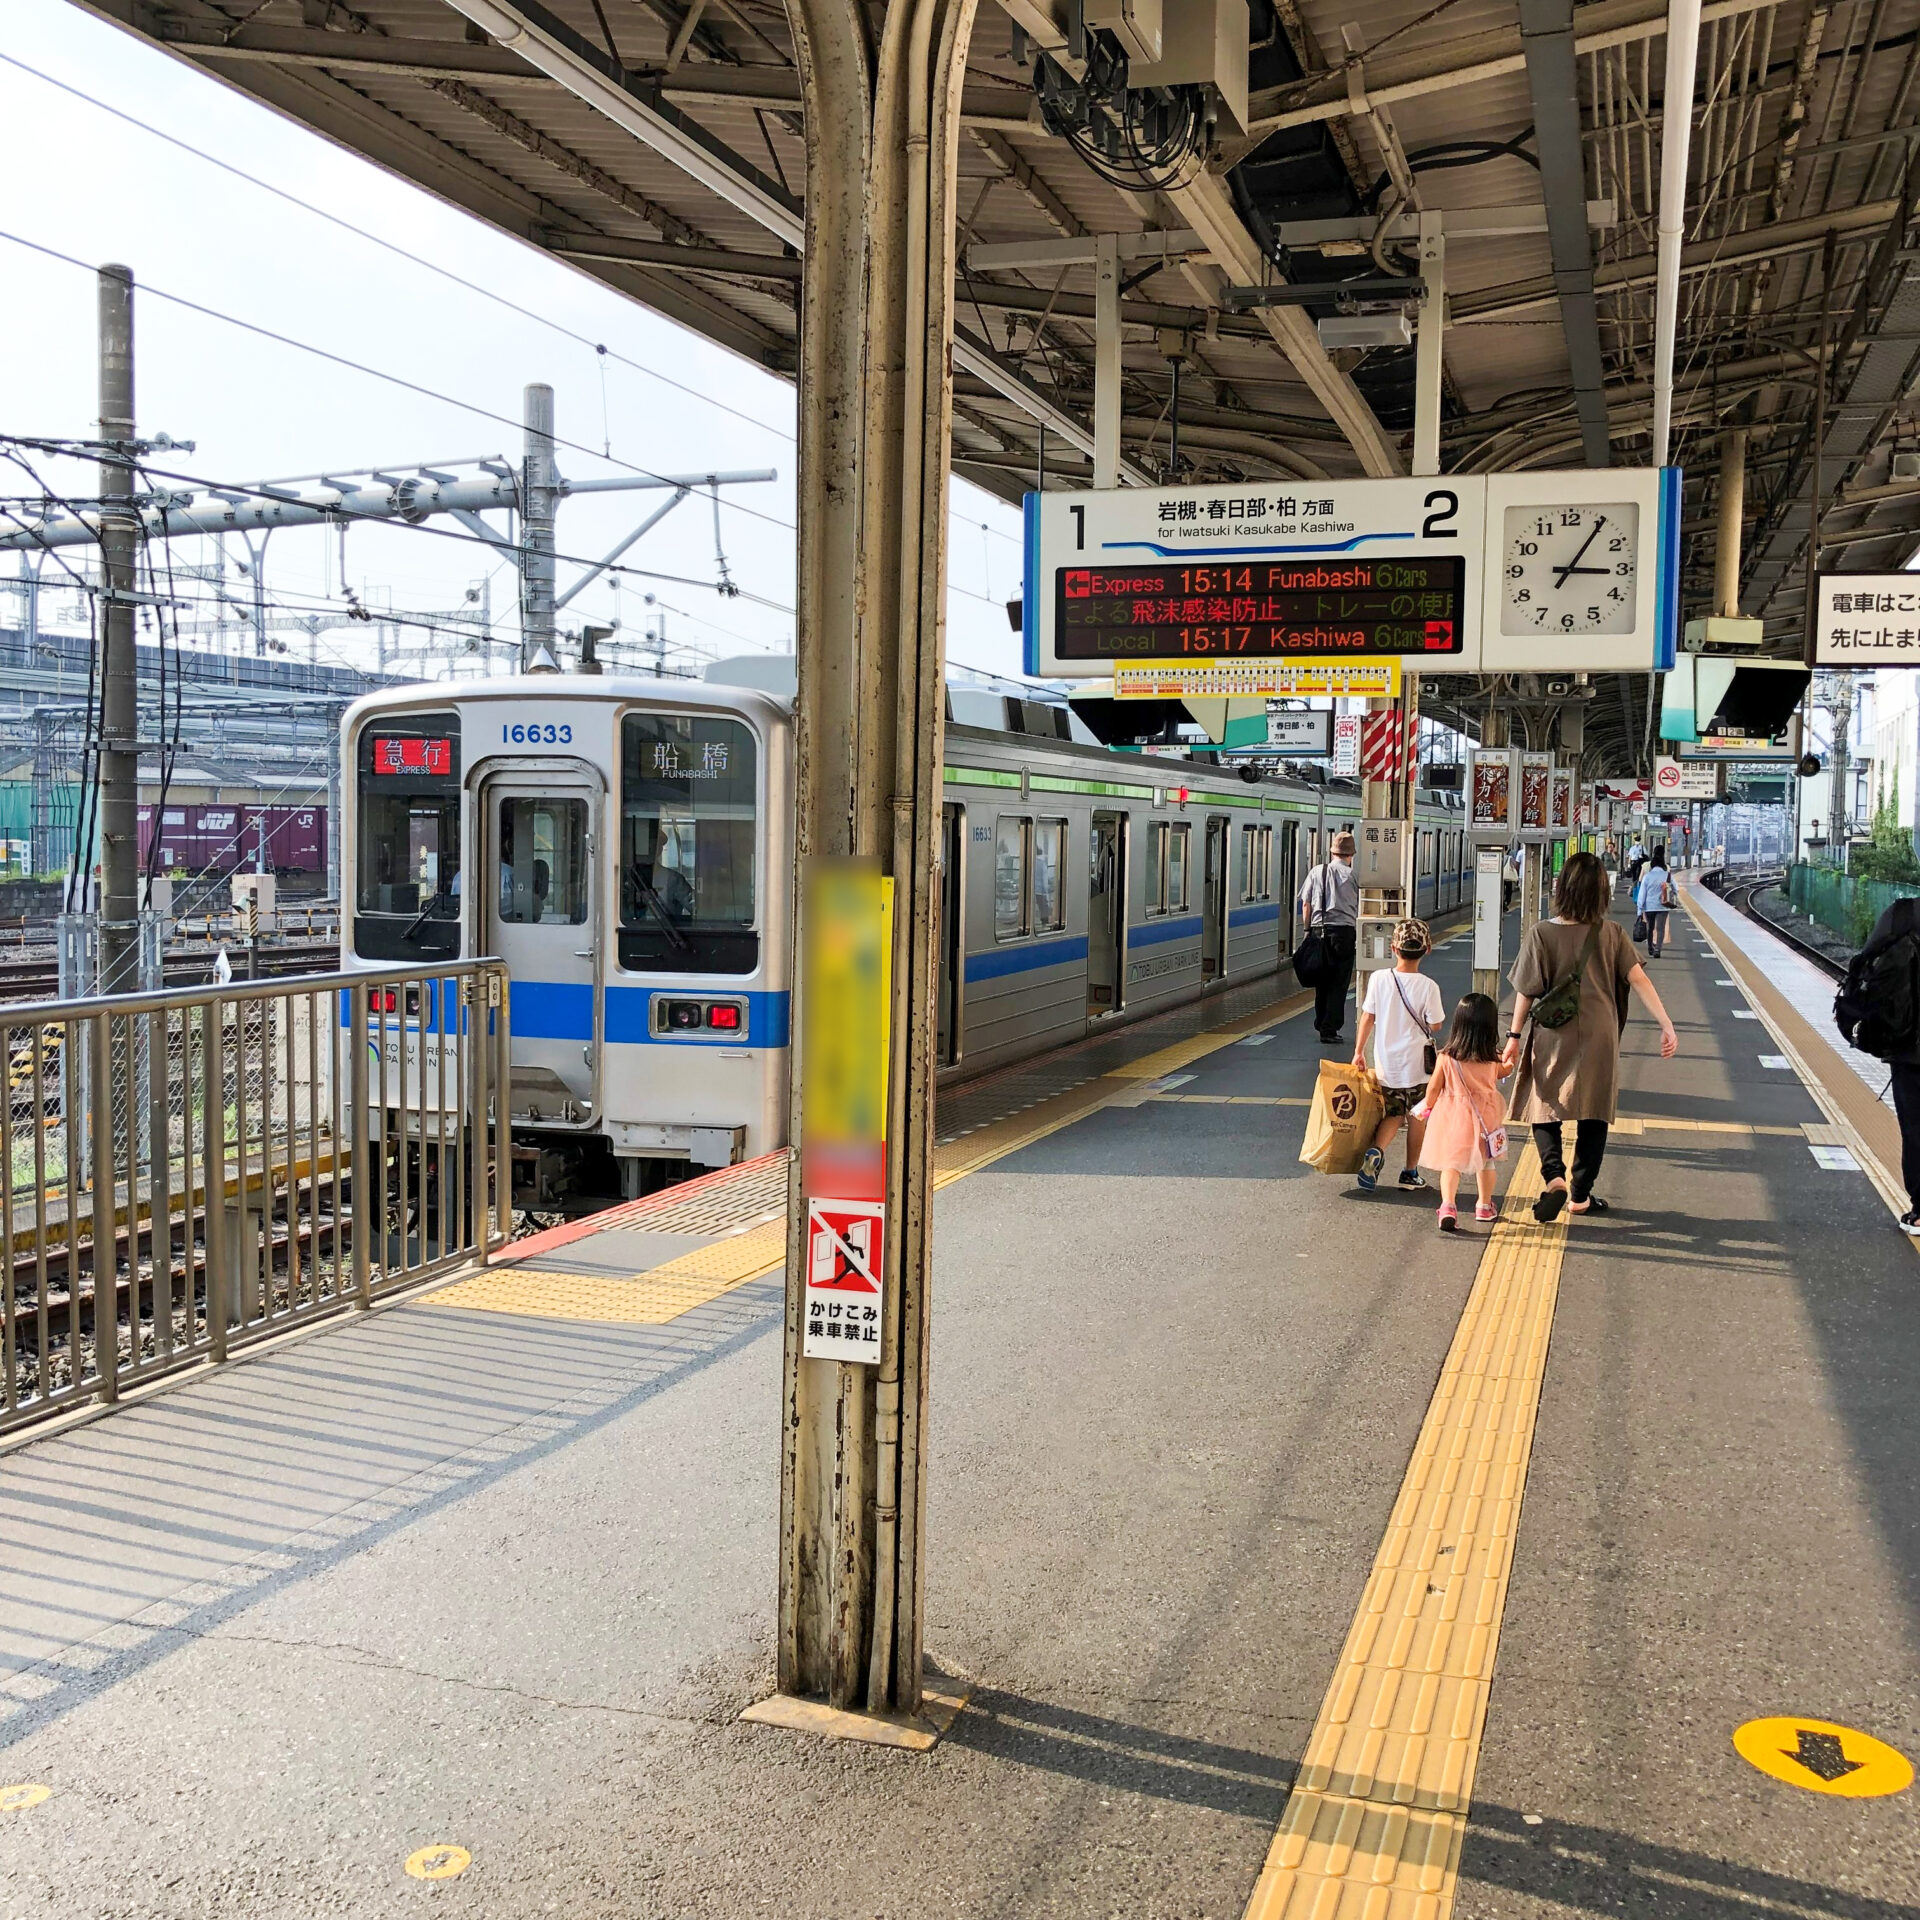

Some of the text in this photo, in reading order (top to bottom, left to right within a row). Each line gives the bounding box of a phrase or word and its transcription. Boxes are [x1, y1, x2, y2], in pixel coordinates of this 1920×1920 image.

[1158, 497, 1335, 521] 岩槻・春日部・柏 方面
[1422, 490, 1459, 538] 2
[1560, 513, 1581, 526] 12
[1070, 505, 1085, 550] 1
[1158, 520, 1355, 538] for Iwatsuki Kasukabe Kashiwa
[1537, 523, 1554, 535] 11
[1519, 543, 1538, 556] 10
[1609, 538, 1622, 551] 2
[1511, 565, 1524, 578] 9
[1616, 563, 1628, 576] 3
[1091, 575, 1164, 596] Express
[1180, 567, 1252, 593] 15:14
[1268, 566, 1371, 588] Funabashi
[1518, 588, 1531, 602] 8
[1607, 587, 1620, 600] 4
[1832, 593, 1920, 613] 電車はこ
[1536, 608, 1549, 621] 7
[1587, 606, 1600, 620] 5
[1561, 614, 1574, 627] 6
[1097, 630, 1156, 650] Local
[1179, 626, 1252, 652] 15:17
[1270, 626, 1365, 648] Kashiwa
[1830, 627, 1920, 648] 先に止ま
[1266, 722, 1315, 730] ・春日部・柏
[503, 724, 573, 744] 16633
[384, 739, 442, 766] 急行
[653, 742, 728, 769] 船橋
[396, 765, 431, 775] EXPRESS
[662, 769, 718, 778] FUNABASHI
[972, 826, 992, 842] 16633
[1366, 828, 1397, 842] 電話
[385, 1043, 458, 1057] TOU RBAN
[386, 1055, 415, 1065] PAK
[810, 1301, 878, 1322] かけこみ
[808, 1320, 878, 1342] 乗車禁止
